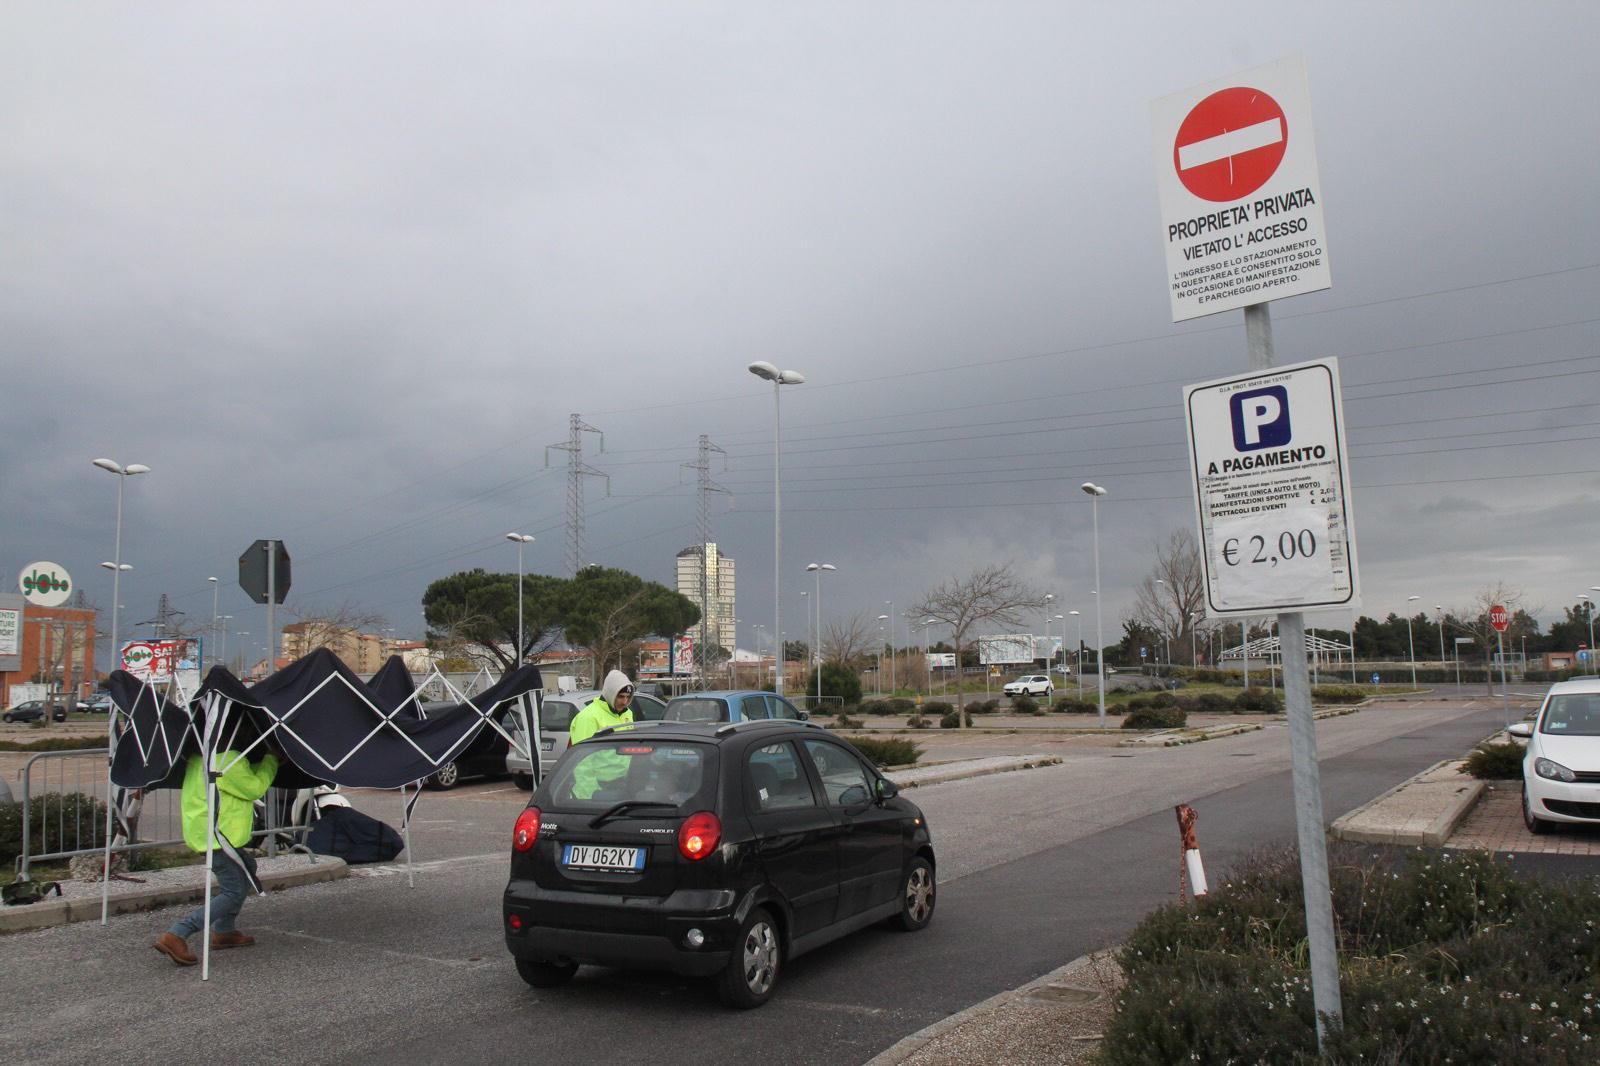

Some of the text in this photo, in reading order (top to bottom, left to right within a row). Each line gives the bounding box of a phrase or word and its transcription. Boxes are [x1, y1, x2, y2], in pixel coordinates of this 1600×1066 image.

[1168, 187, 1315, 242] PROPRIETA' PRIVATA
[1183, 237, 1231, 261] VIETATO
[1247, 217, 1308, 245] ACCESSO
[1174, 262, 1222, 280] L'INGRESSO
[1230, 257, 1242, 266] LO
[1243, 238, 1317, 263] STAZIONAMENTO
[1181, 270, 1233, 288] QUEST'AREA
[1240, 254, 1296, 273] CONSENTITO
[1297, 247, 1322, 260] SOLO
[1177, 258, 1321, 299] IN OCCASIONE DI MANIFESTAZIONE
[1198, 274, 1300, 304] E PARCHEGGIO APERTO.
[1241, 394, 1281, 445] P
[1208, 462, 1219, 475] A
[1222, 445, 1326, 473] PAGAMENTO
[1210, 498, 1264, 509] MANIFESTAZIONI
[1265, 492, 1300, 502] SPORTIVE
[1223, 491, 1249, 500] TARIFFE
[1250, 488, 1272, 497] (UNICA
[1298, 481, 1321, 490] MOTO)
[1210, 508, 1250, 518] SPETTACOLI
[1261, 503, 1287, 511] EVENTI
[1221, 538, 1240, 566] €
[1249, 529, 1316, 568] 2,00
[23, 569, 69, 596] globo
[1491, 612, 1507, 623] STOP
[571, 847, 636, 866] DV 062KY
